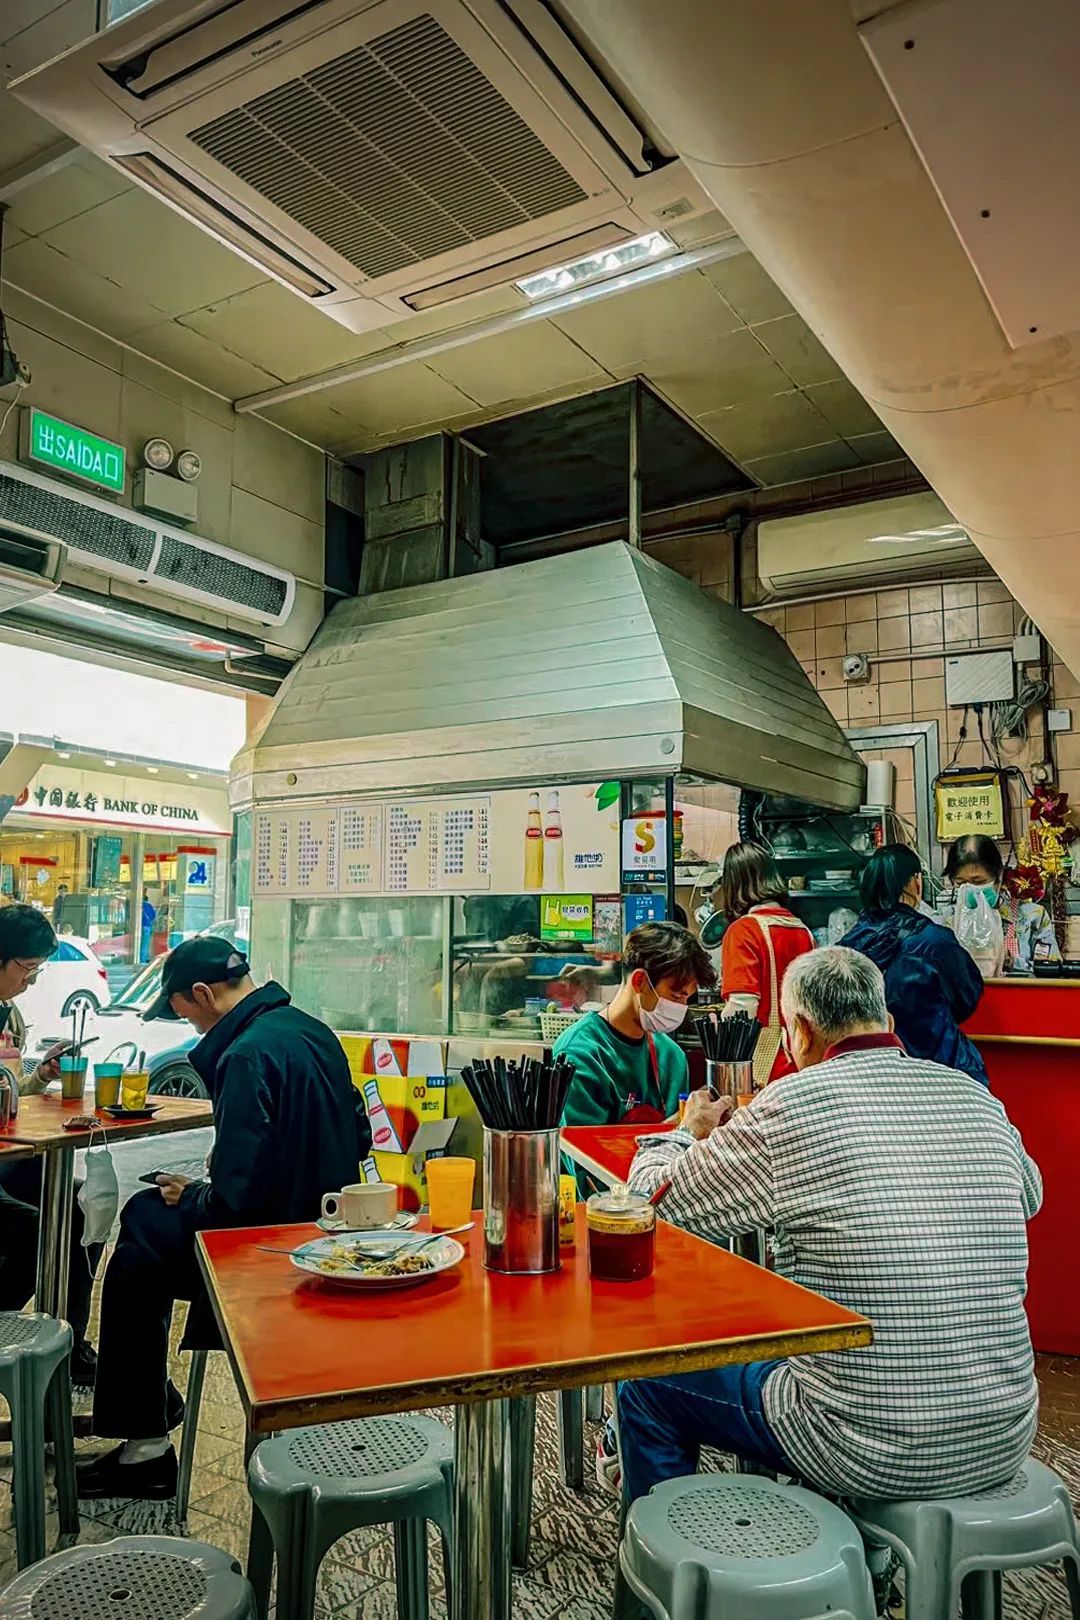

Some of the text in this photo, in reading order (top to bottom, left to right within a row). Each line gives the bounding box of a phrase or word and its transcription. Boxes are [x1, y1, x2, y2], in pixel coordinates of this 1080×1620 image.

[947, 795, 990, 808] 歡迎使用
[103, 798, 138, 813] BANK
[141, 803, 158, 815] OF
[160, 805, 199, 821] CHINA
[945, 810, 993, 822] 電子消費卡
